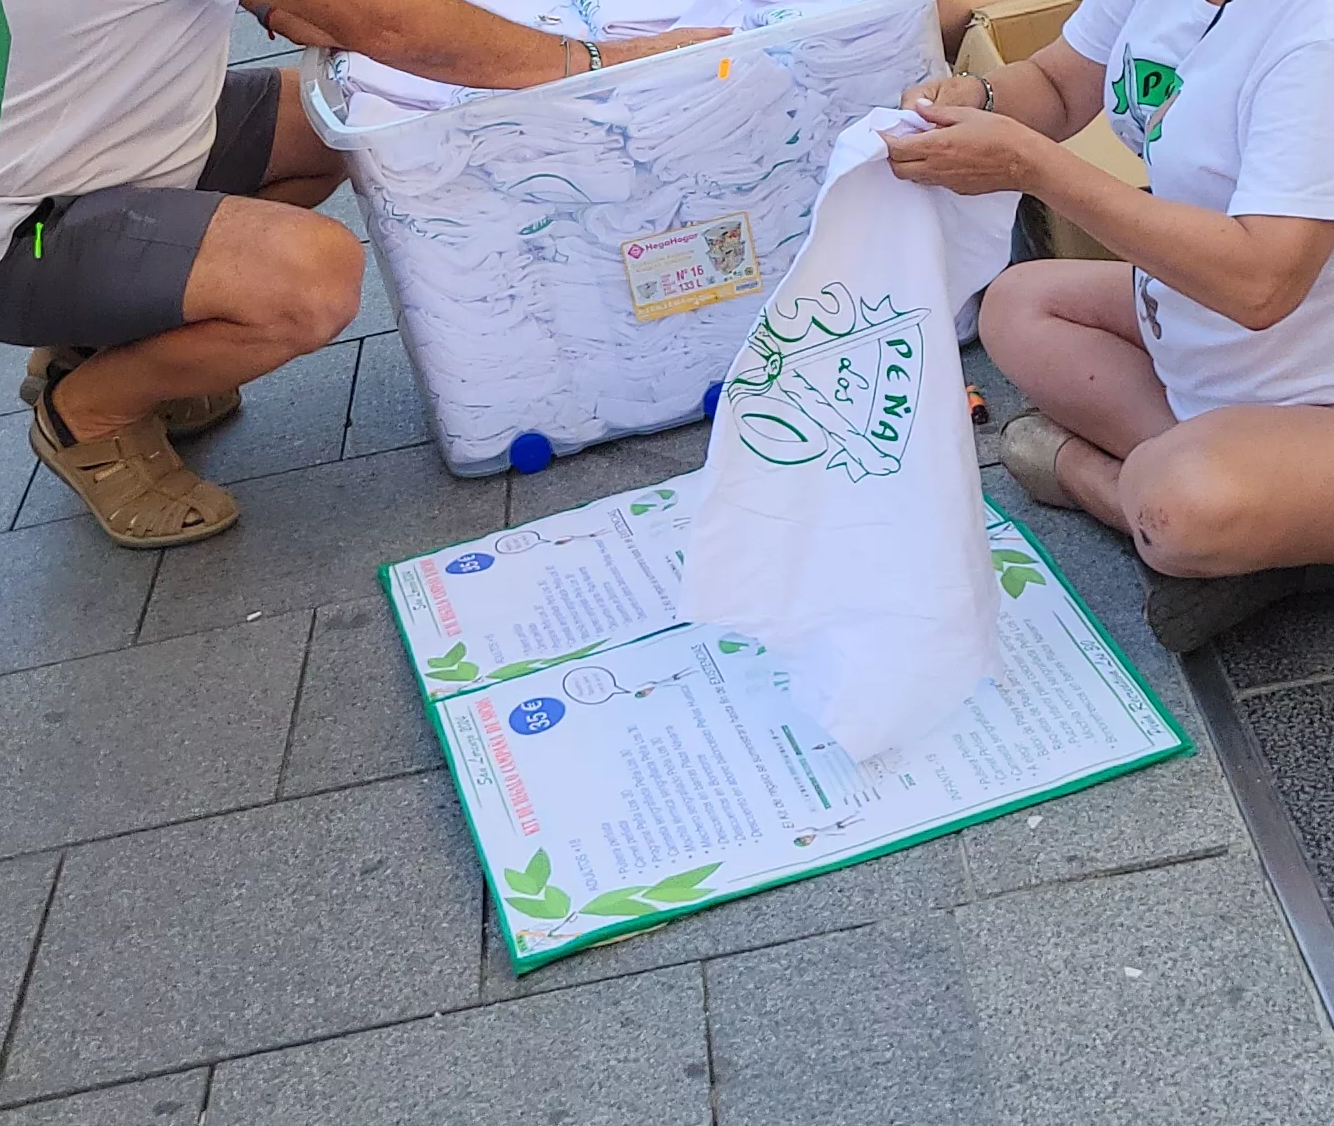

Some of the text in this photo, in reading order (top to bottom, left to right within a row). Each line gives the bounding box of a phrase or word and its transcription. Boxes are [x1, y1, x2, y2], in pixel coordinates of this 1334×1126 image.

[678, 280, 695, 292] 133
[696, 278, 703, 288] L
[460, 559, 480, 573] 35
[690, 643, 720, 685] EXISTENCIAS
[519, 697, 551, 731] 35 €
[473, 766, 492, 787] San
[503, 773, 530, 806] REGALO
[574, 853, 600, 892] ADULTOS
